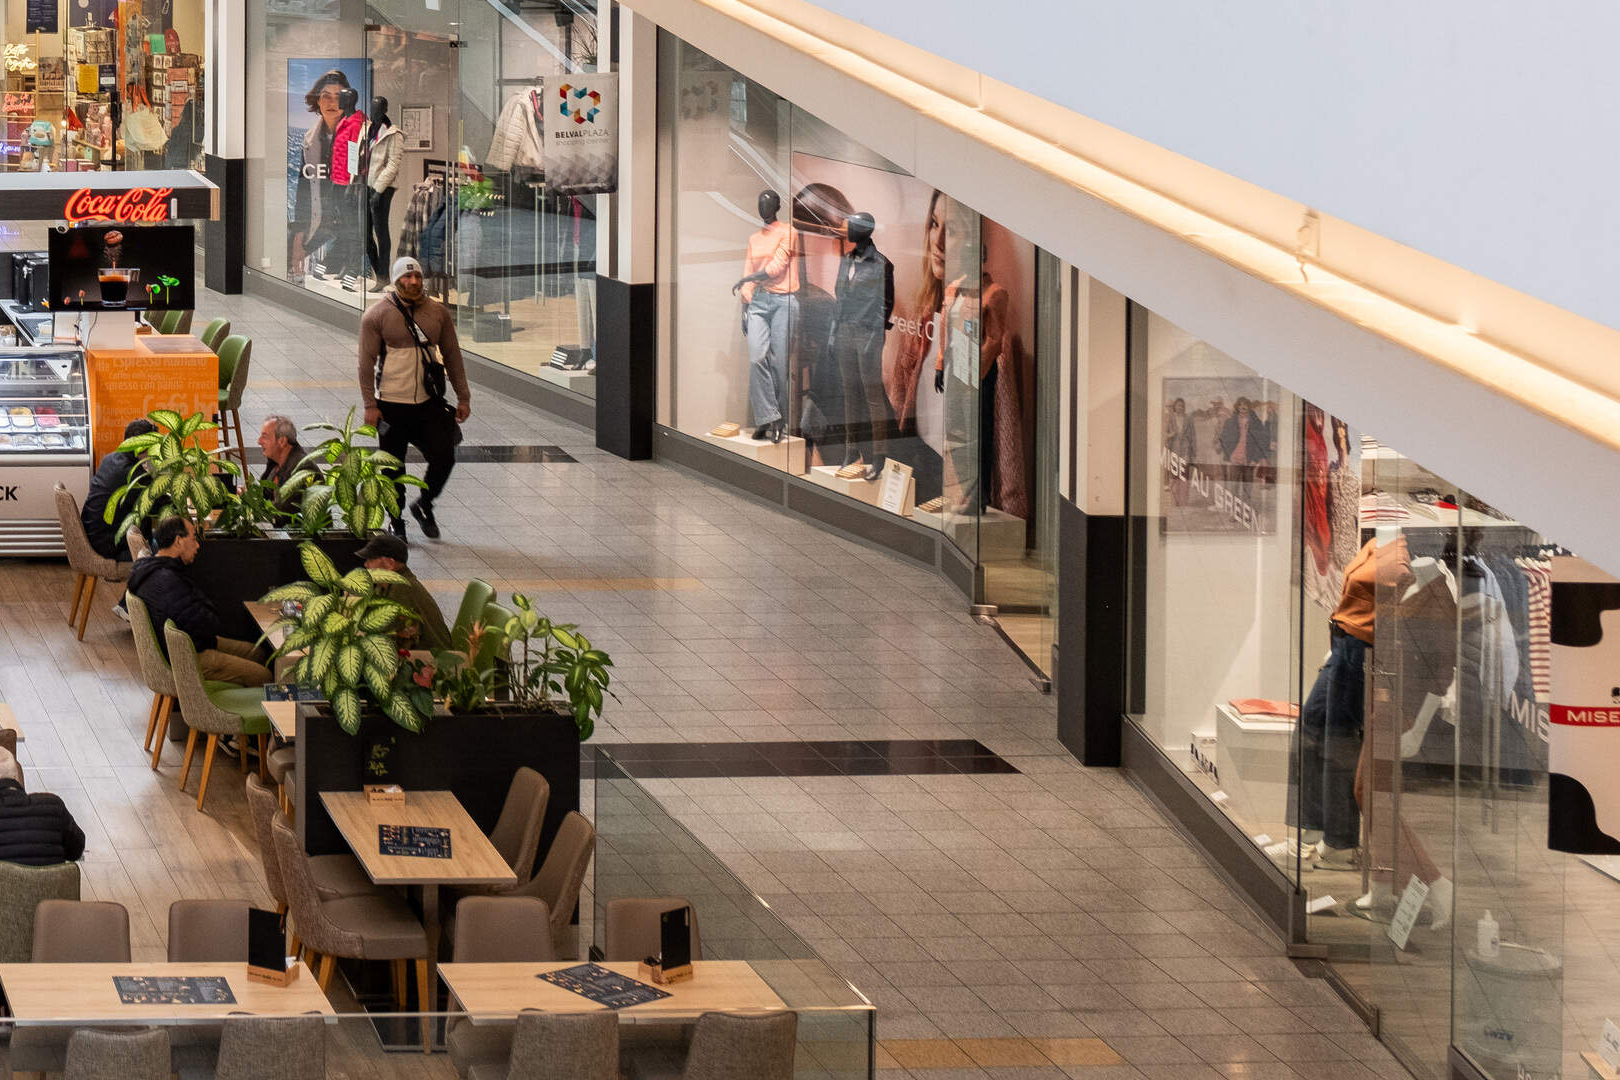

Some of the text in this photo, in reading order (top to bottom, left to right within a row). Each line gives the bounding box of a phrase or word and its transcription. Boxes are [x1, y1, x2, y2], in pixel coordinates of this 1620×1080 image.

[555, 128, 610, 139] BELVALPLAZA
[64, 187, 174, 223] Coca-Cola
[1191, 467, 1209, 498] AU
[1214, 483, 1263, 532] GREEN
[1567, 710, 1620, 724] MISE
